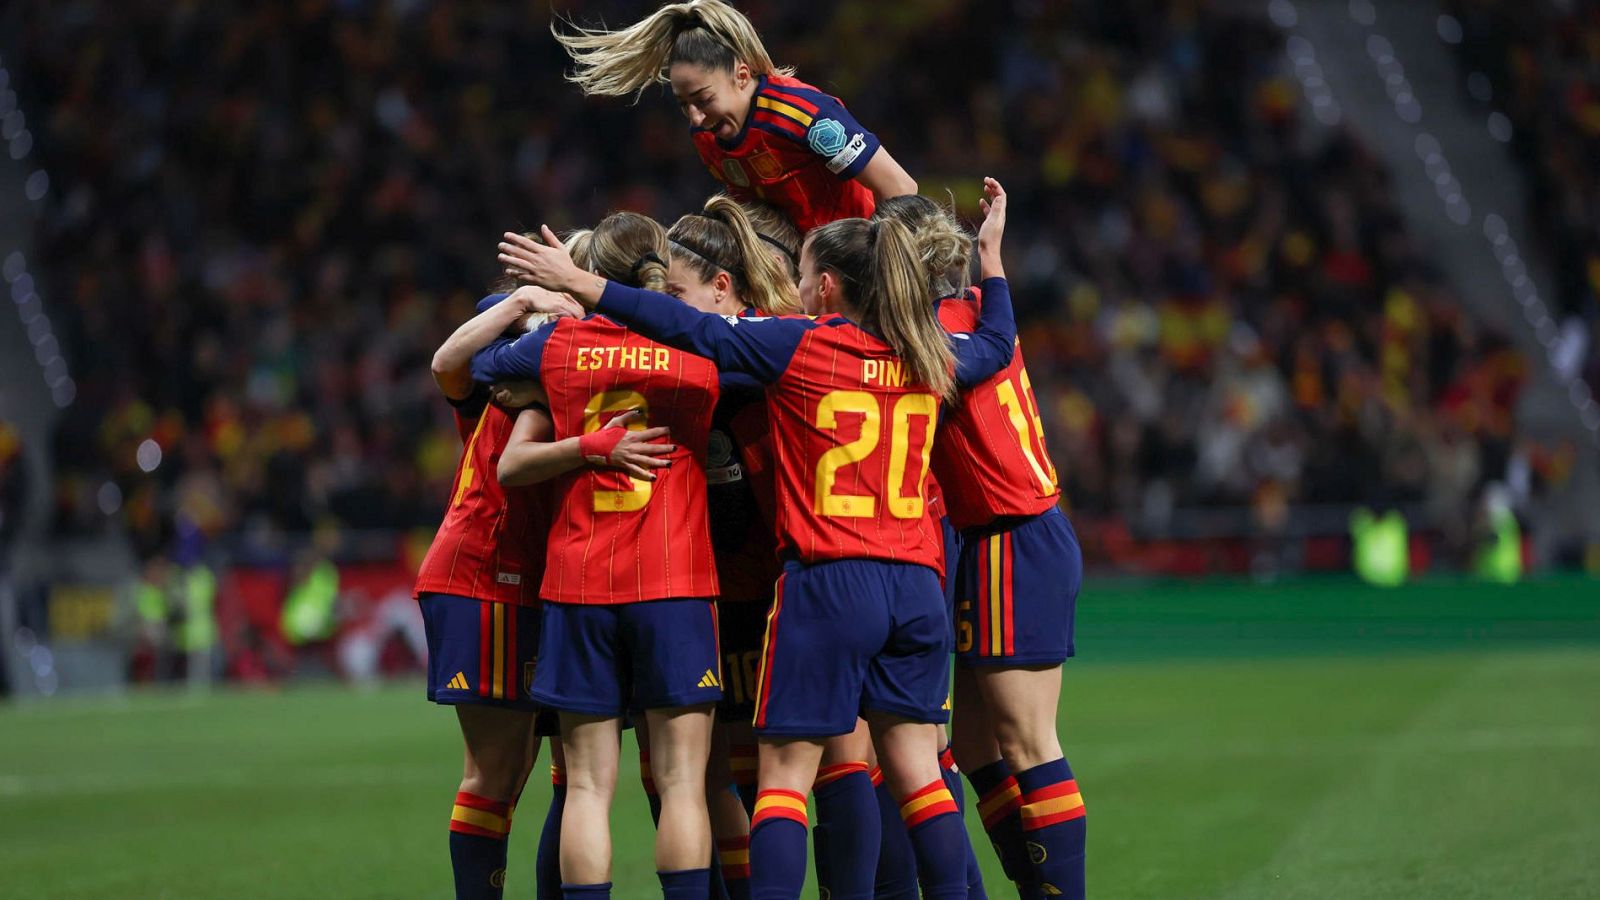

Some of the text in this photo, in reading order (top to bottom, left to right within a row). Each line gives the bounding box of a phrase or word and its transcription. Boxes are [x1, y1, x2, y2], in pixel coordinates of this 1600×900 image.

[576, 346, 669, 371] ESTHER
[584, 389, 652, 513] 9
[814, 390, 938, 520] 20
